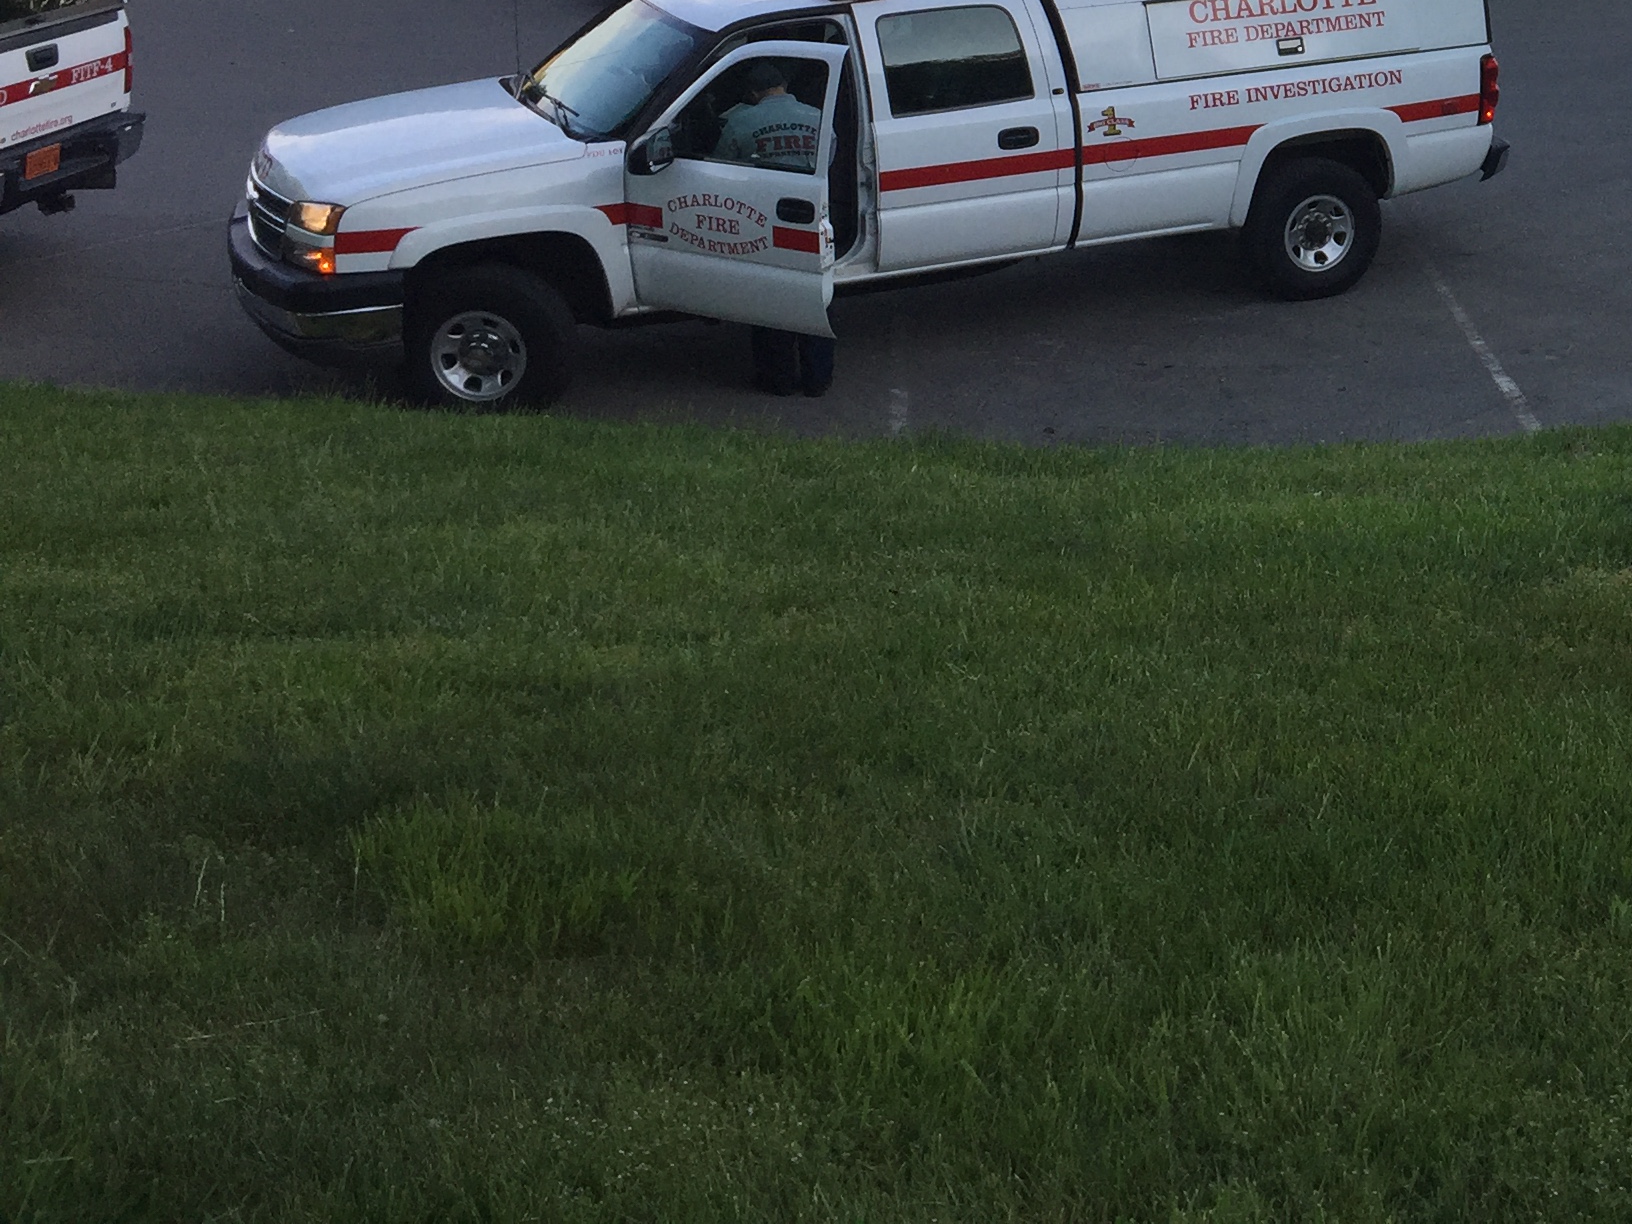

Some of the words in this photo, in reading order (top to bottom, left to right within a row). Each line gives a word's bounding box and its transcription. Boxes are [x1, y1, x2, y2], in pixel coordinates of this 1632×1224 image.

[1186, 27, 1239, 49] FIRE
[1244, 10, 1387, 42] DEPARTMENT
[70, 57, 113, 84] FITF-4
[1189, 89, 1240, 111] FIRE
[1245, 69, 1404, 104] INVESTIGATION
[10, 115, 73, 142] charlottefire.org
[752, 122, 818, 138] CHARLOTTE
[755, 134, 816, 153] FIRE
[667, 193, 768, 227] CHARLOTTE
[695, 213, 740, 235] FIRE
[668, 221, 770, 255] DEPARTMENT
